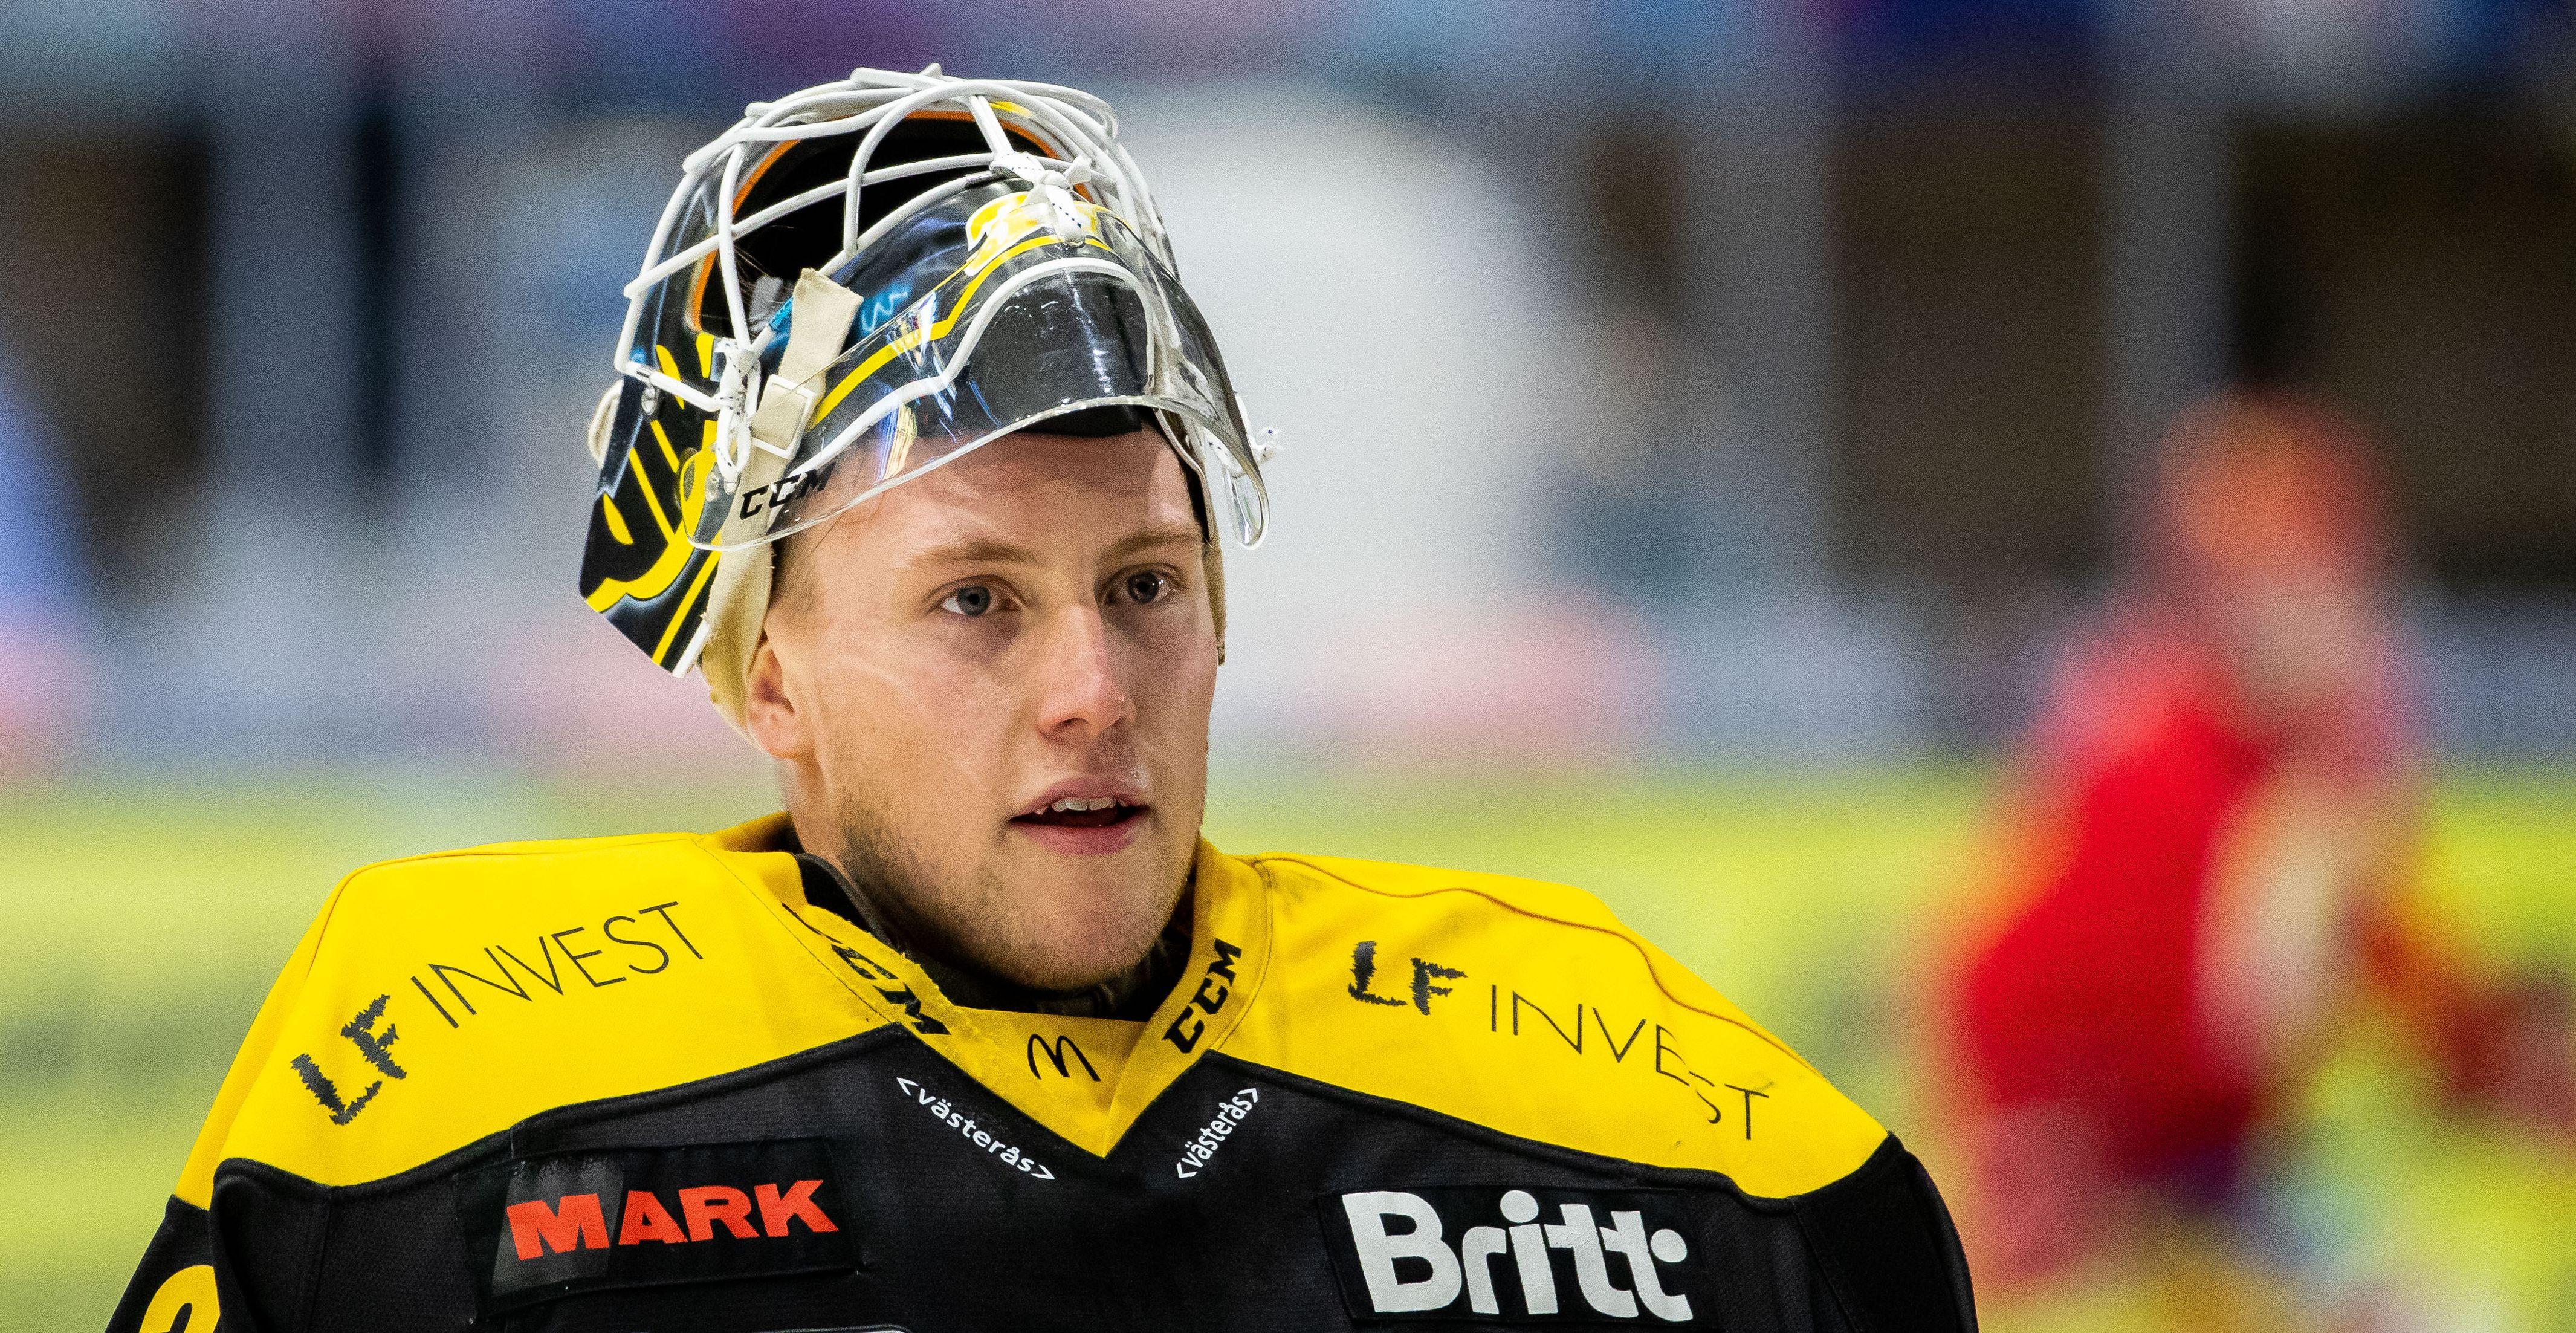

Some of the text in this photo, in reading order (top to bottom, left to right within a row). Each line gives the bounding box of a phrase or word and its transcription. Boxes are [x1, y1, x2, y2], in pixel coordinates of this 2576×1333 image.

[740, 463, 837, 521] CCM
[291, 901, 703, 1126] LF INVEST
[1162, 938, 1242, 1054] CCM
[1347, 941, 1769, 1140] LF INVEST
[506, 1179, 839, 1261] MARK
[1341, 1190, 1693, 1322] Britt
